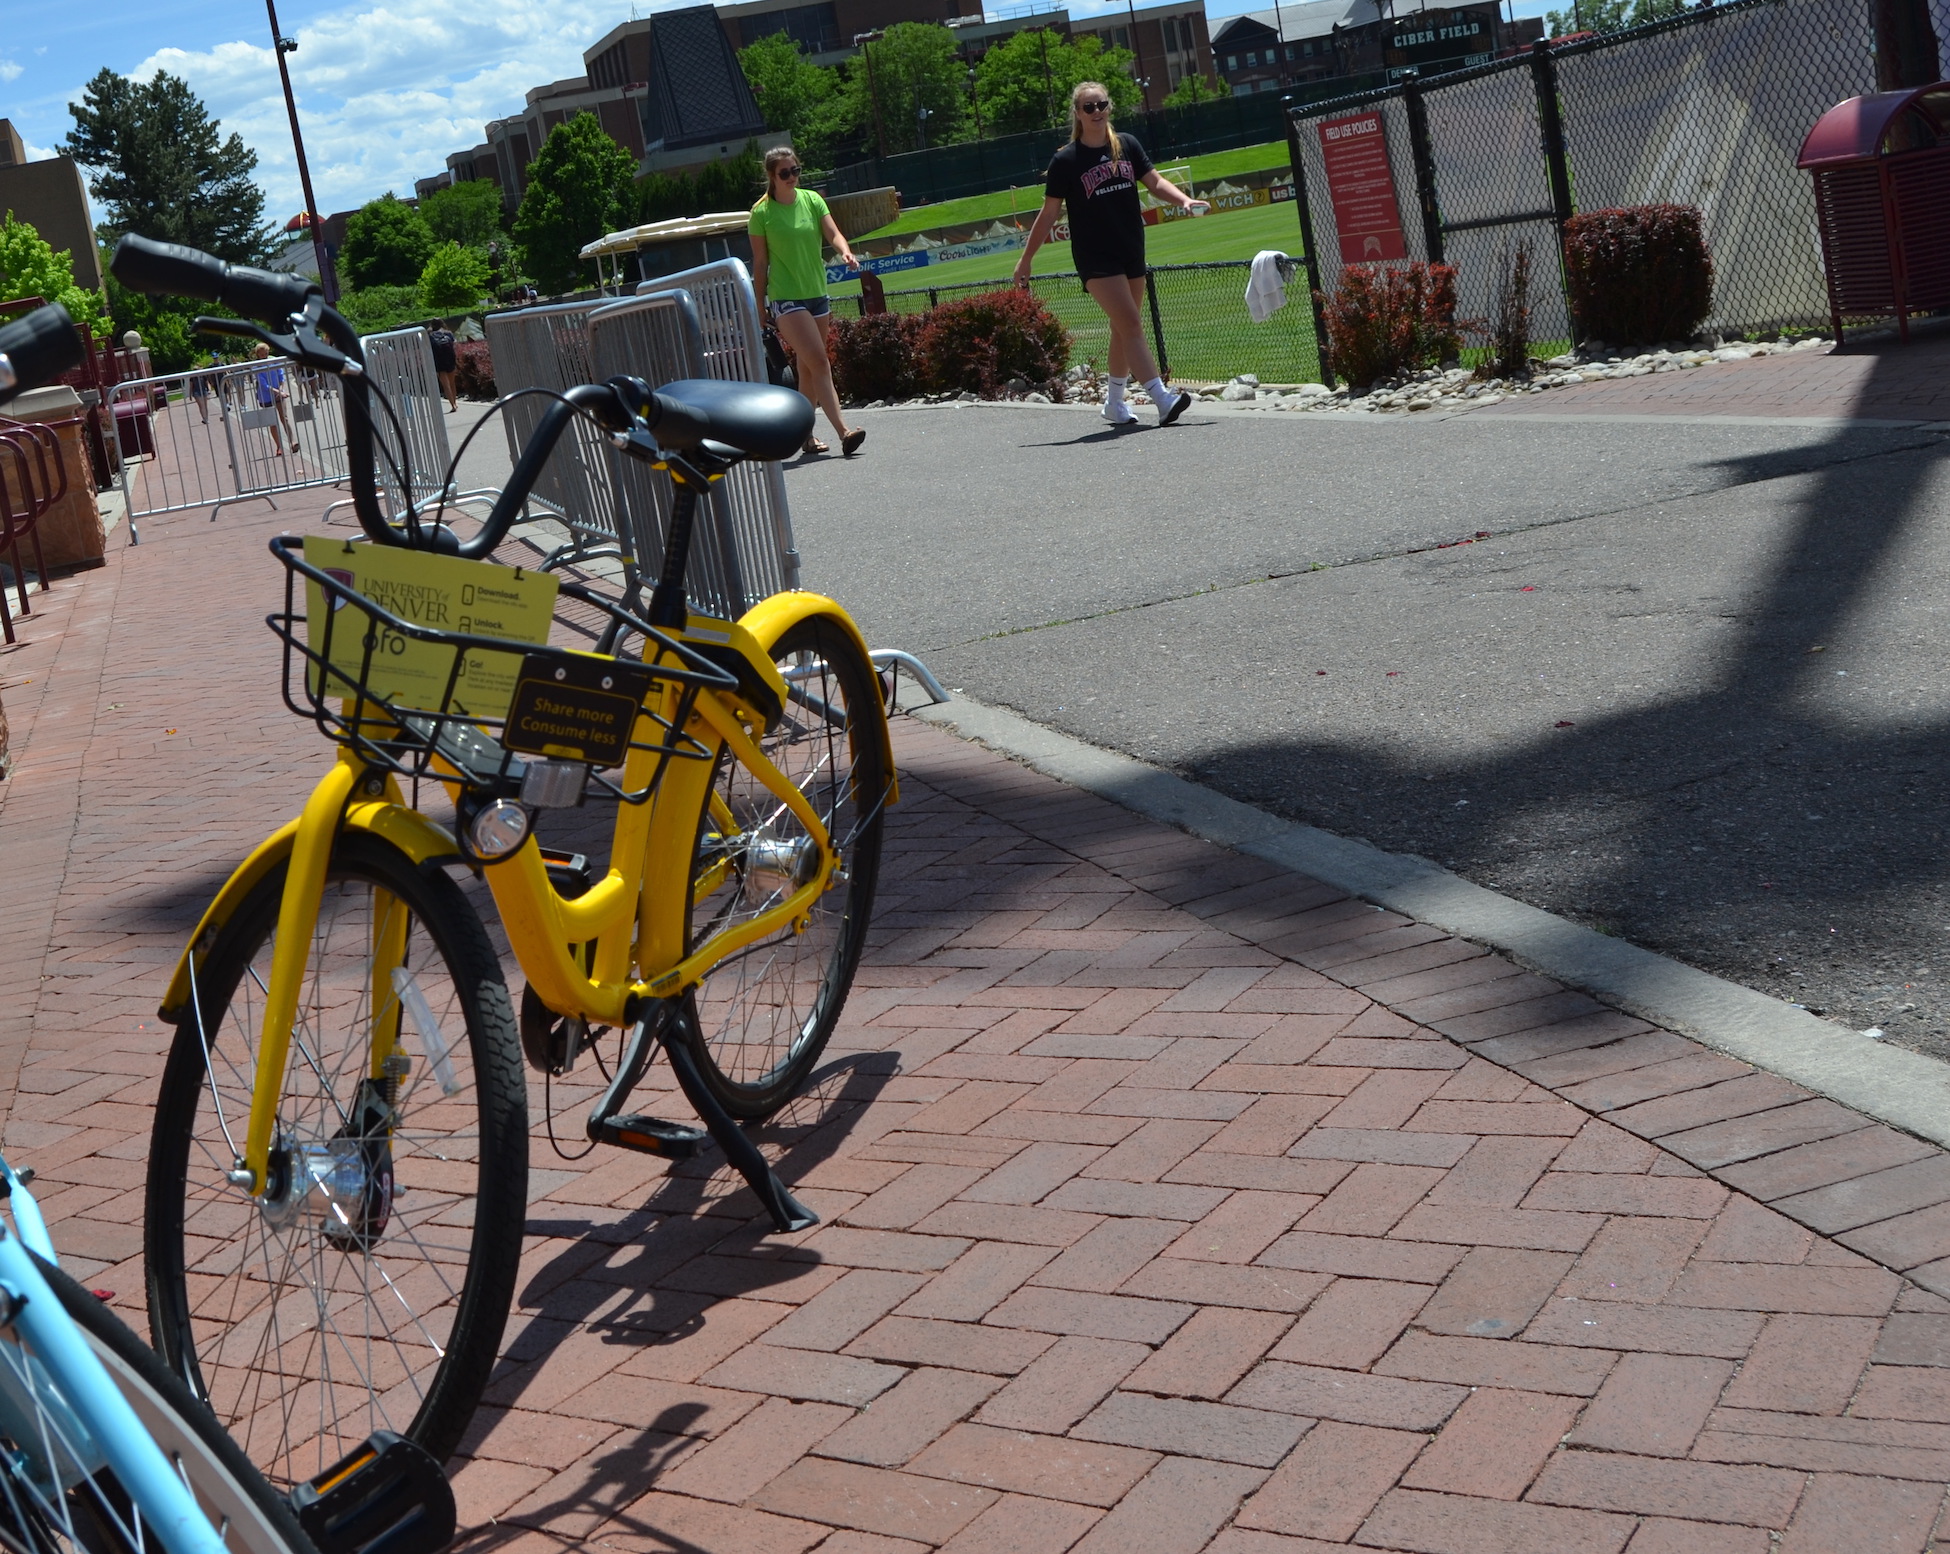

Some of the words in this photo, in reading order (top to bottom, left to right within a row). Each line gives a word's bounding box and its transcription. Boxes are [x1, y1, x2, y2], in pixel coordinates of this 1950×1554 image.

[1394, 30, 1435, 48] CIBER
[1440, 22, 1480, 40] FIELD
[1464, 54, 1490, 66] GUEST
[1325, 126, 1340, 141] FIELD
[1340, 123, 1353, 138] USE
[1352, 118, 1378, 136] POLICIES
[1095, 181, 1133, 196] VOLLEYBALL
[1216, 192, 1254, 209] WICH
[878, 255, 915, 269] Service
[939, 249, 966, 262] Coors
[362, 577, 442, 602] UNIVERSITY
[362, 627, 406, 656] ofo
[534, 697, 574, 717] Share
[577, 706, 614, 725] more
[520, 715, 587, 740] Consume
[590, 727, 617, 745] less
